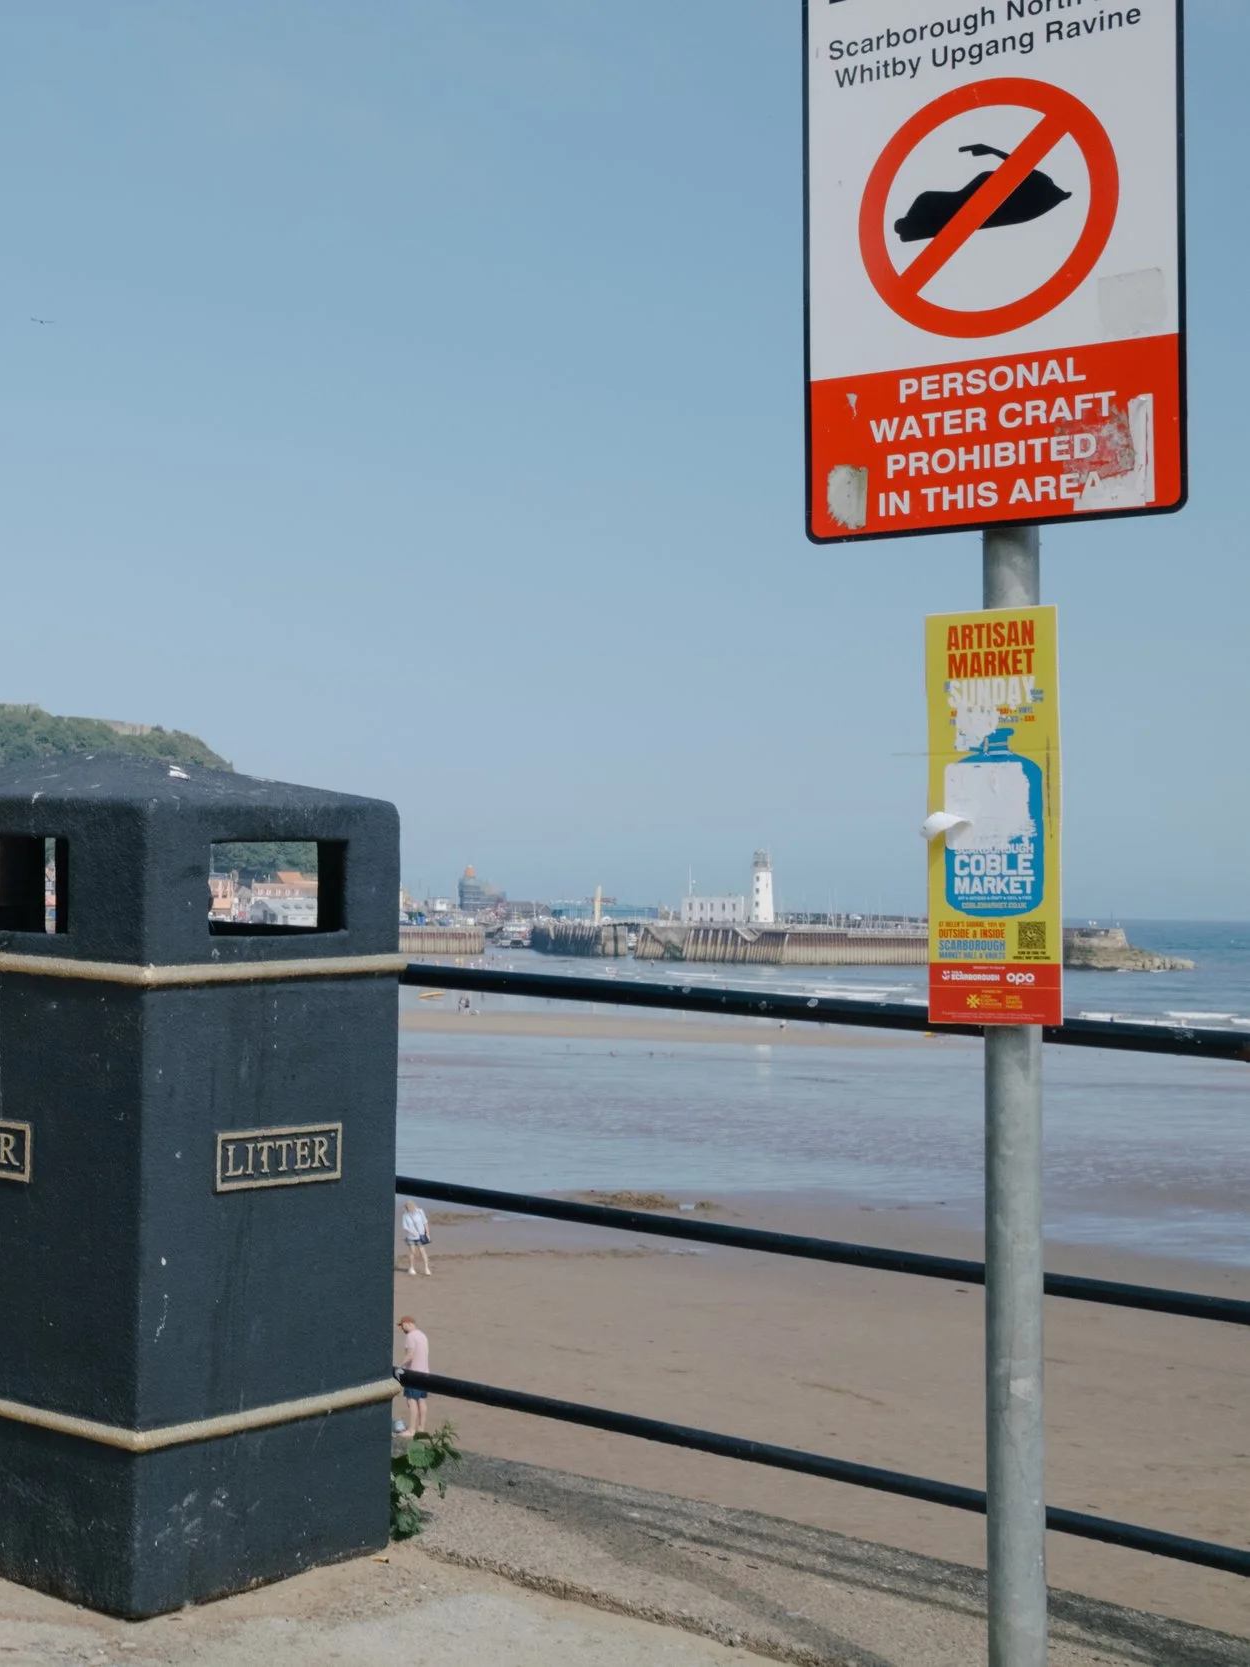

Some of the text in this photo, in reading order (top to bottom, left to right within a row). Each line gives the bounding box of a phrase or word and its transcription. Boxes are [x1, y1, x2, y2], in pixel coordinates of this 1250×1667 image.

[829, 0, 1081, 61] Scarborough Nort
[835, 8, 1141, 89] Whitby Upgang Ravine
[899, 357, 1086, 403] PERSONAL
[870, 390, 1116, 443] WATER CRAFT
[886, 432, 1098, 479] PROHIBITED
[879, 471, 1102, 517] IN THIS AREA
[947, 619, 1035, 651] ARTISAN
[948, 648, 1035, 679] MARKET
[947, 675, 1036, 707] SUNDAY
[954, 854, 1034, 876] COBLE
[954, 876, 1035, 895] MARKET
[939, 929, 970, 938] OUTSIDE
[980, 929, 1006, 938] INSIDE
[939, 940, 1006, 951] SCARBOROUGH
[1006, 972, 1035, 985] opo
[225, 1137, 331, 1176] LITTER
